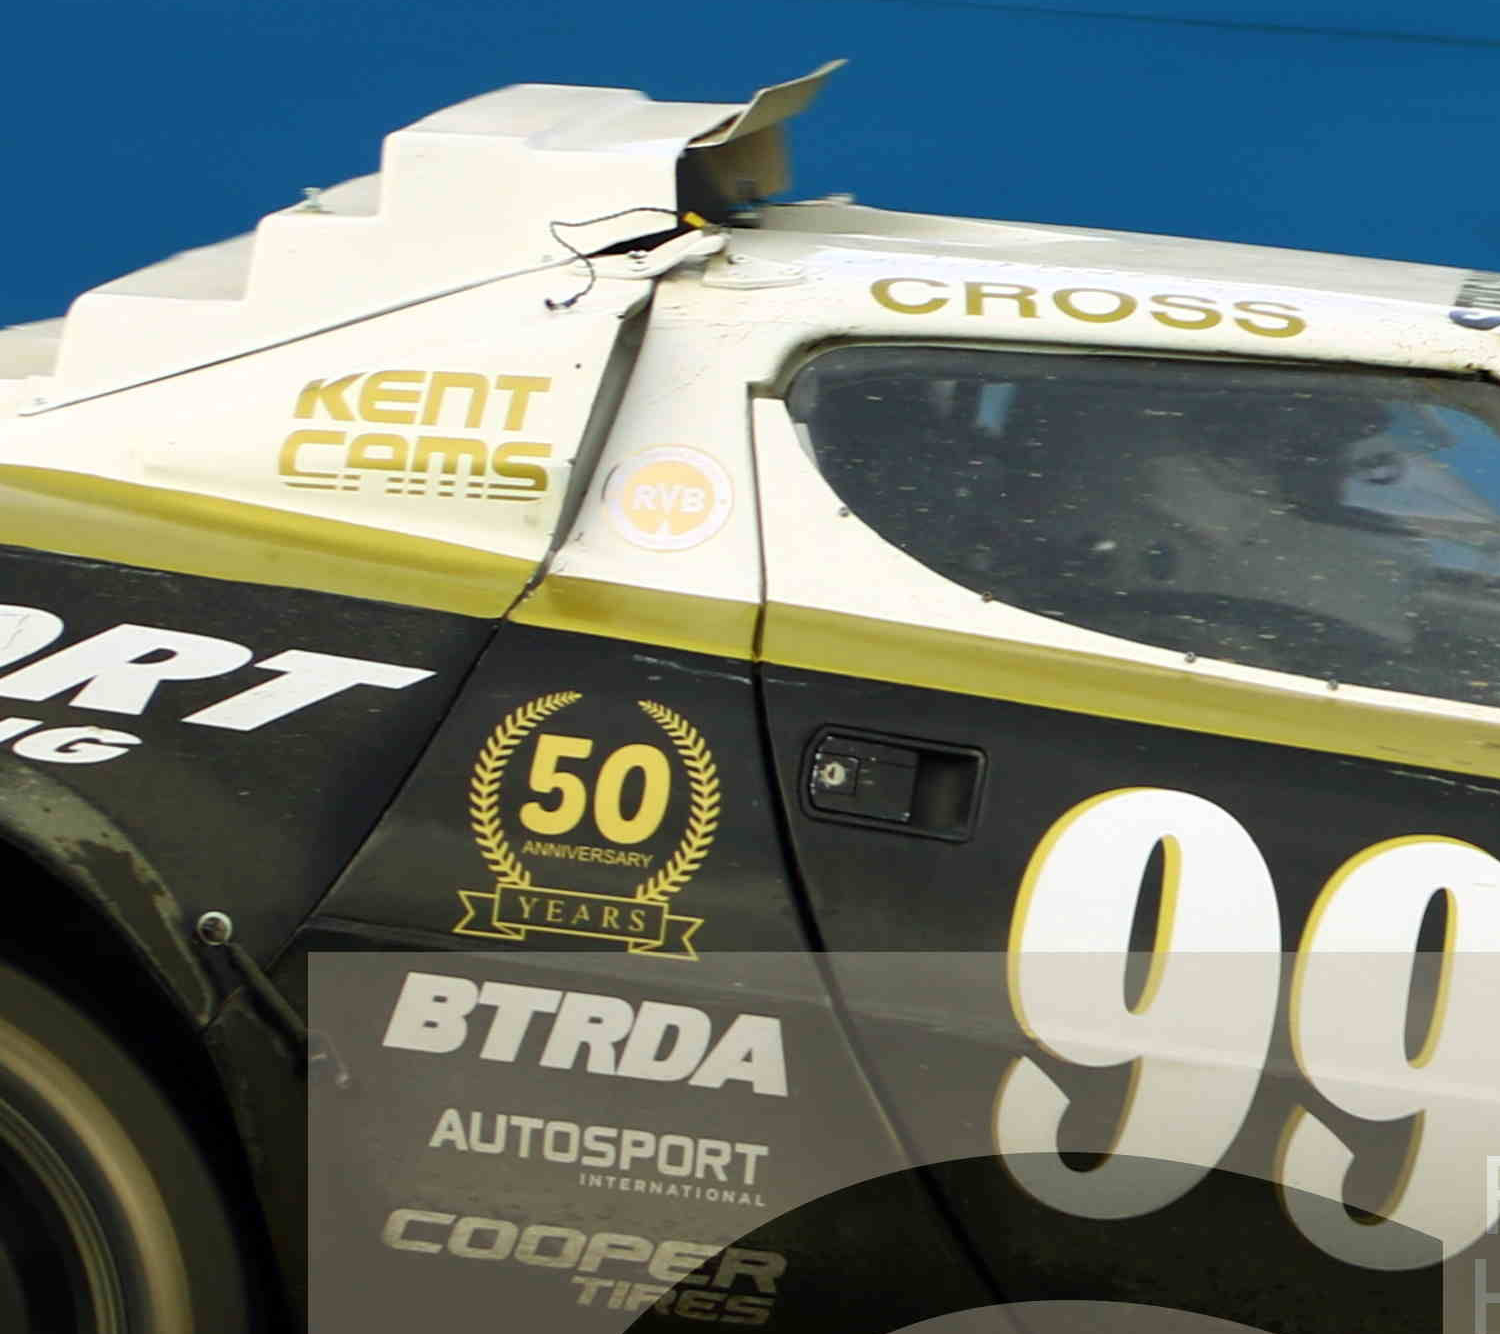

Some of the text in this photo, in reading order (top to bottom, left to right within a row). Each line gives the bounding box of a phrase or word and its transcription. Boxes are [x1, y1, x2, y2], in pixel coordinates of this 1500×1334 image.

[869, 276, 1309, 340] CROSS
[292, 369, 552, 432] KENT
[278, 429, 553, 501] CAMS
[519, 733, 672, 845] 50
[521, 839, 653, 869] ANNIVERSARY
[518, 895, 648, 932] YEARS
[381, 971, 789, 1098] BTRDA
[428, 1107, 769, 1185] AUTOSPORT
[580, 1173, 766, 1208] INTERNATIONAL
[381, 1207, 788, 1294] COOPER
[571, 1274, 775, 1328] TIRES
